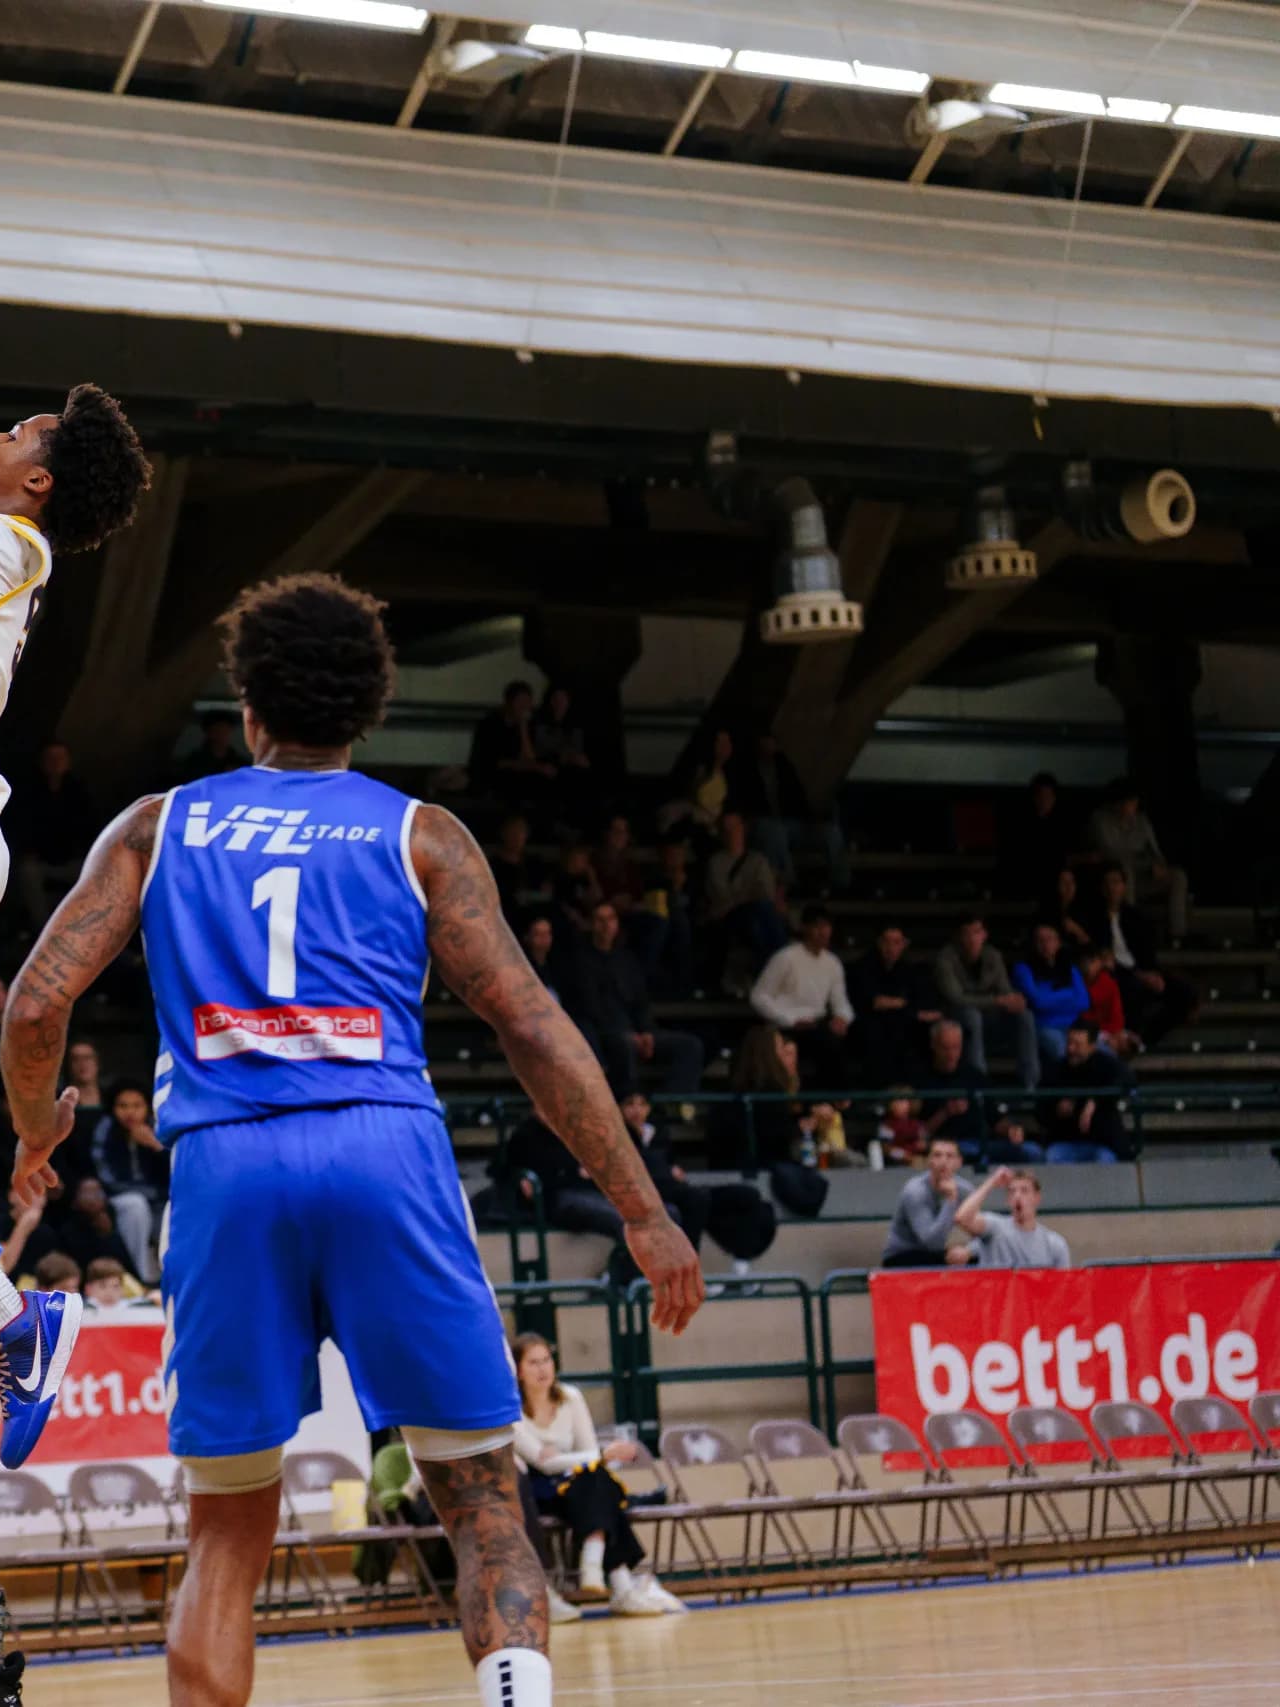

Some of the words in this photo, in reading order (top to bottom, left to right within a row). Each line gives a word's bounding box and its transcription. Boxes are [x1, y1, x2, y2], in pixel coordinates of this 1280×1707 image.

[299, 824, 383, 843] STADE
[251, 866, 301, 999] 1
[230, 1032, 337, 1053] STADE
[909, 1312, 1259, 1415] bett1.de
